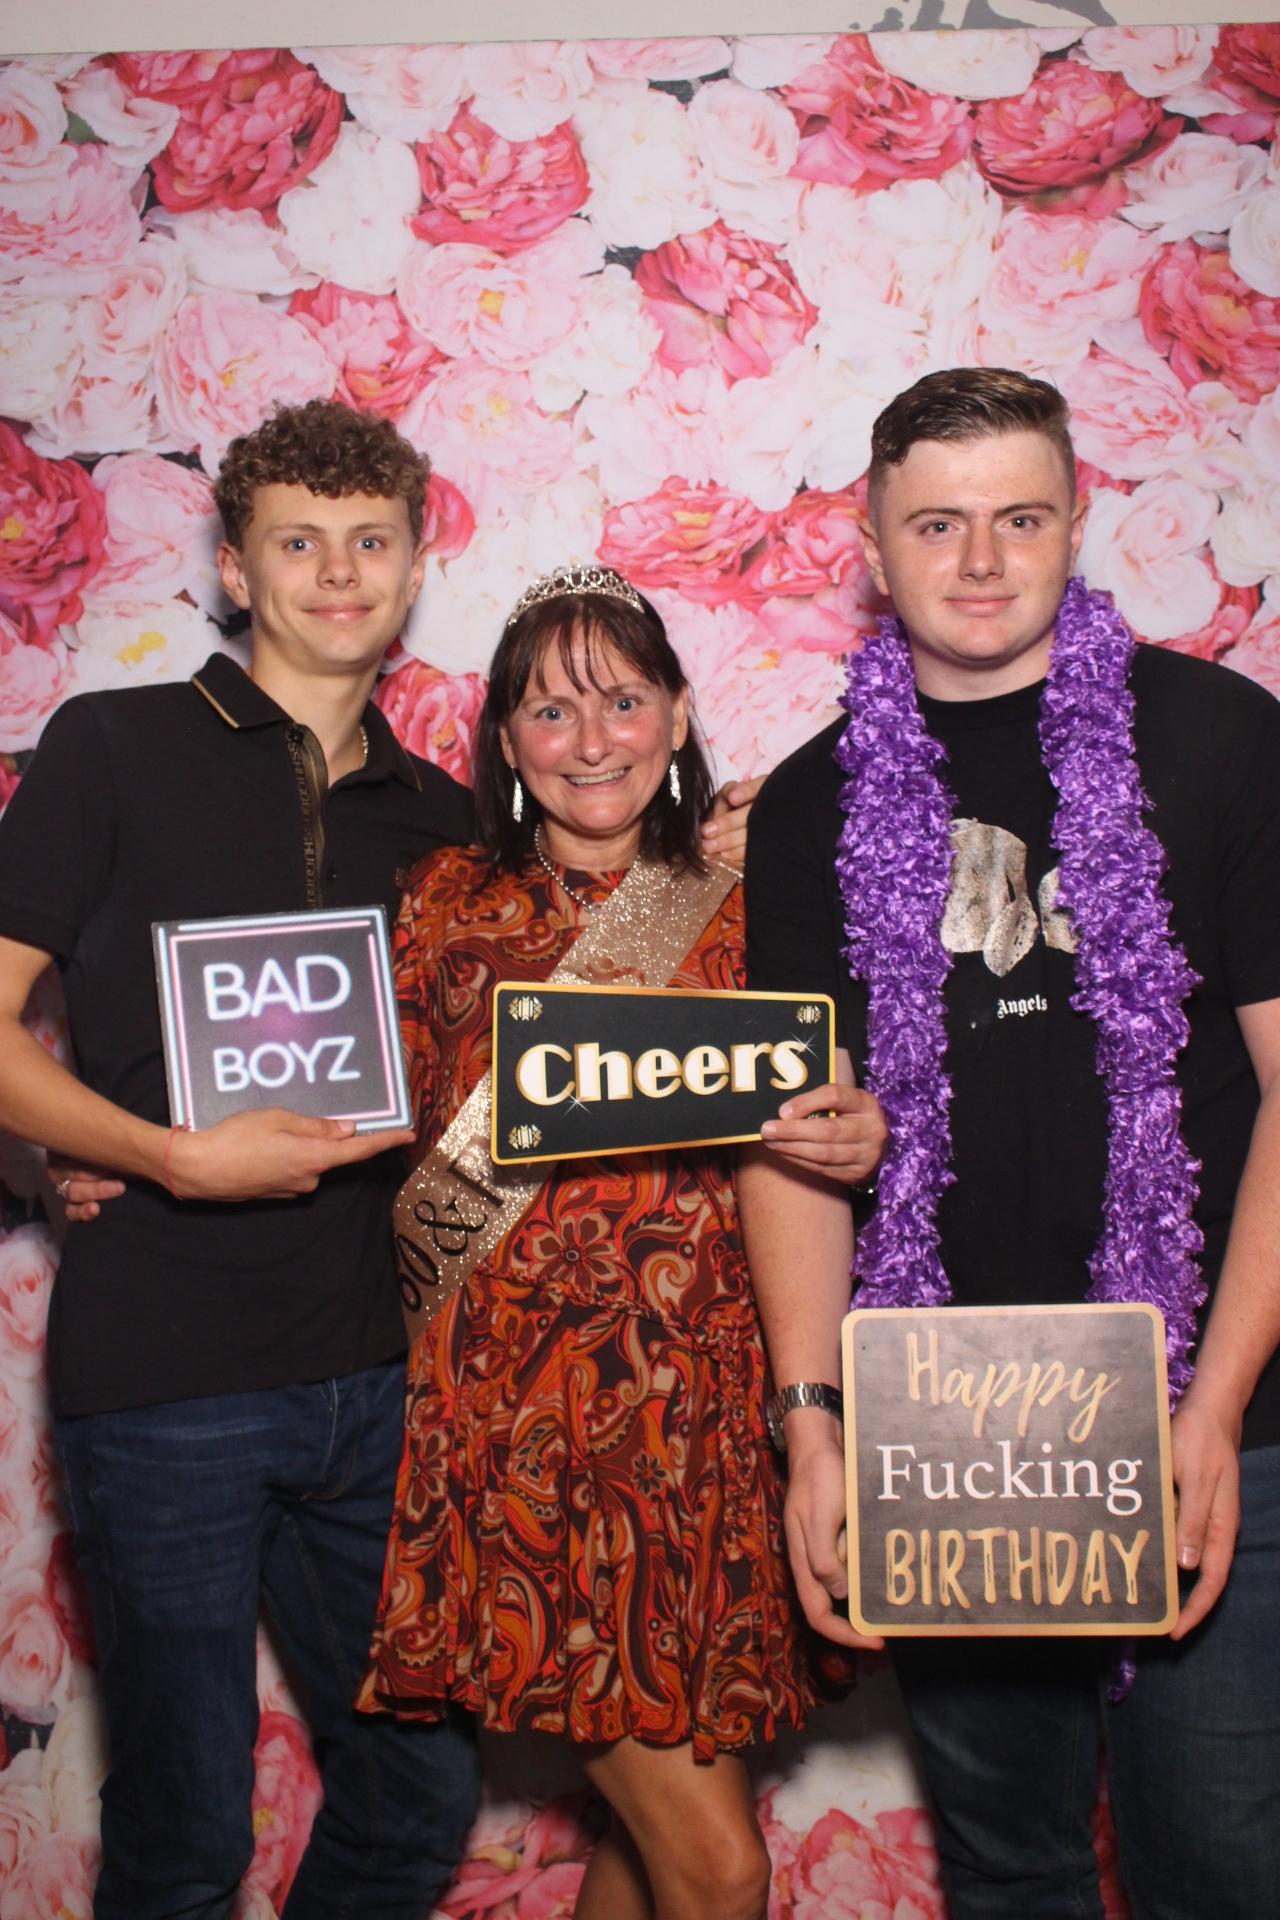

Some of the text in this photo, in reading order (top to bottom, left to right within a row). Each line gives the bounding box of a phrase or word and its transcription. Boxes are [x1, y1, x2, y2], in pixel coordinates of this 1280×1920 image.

[203, 955, 351, 1021] BAD
[997, 993, 1048, 1019] Angels
[213, 1036, 361, 1092] BOYZ
[515, 1039, 808, 1106] Cheers
[906, 1328, 1121, 1443] Happy
[876, 1439, 1143, 1516] Fucking
[885, 1526, 1150, 1609] BIRTHDAY
